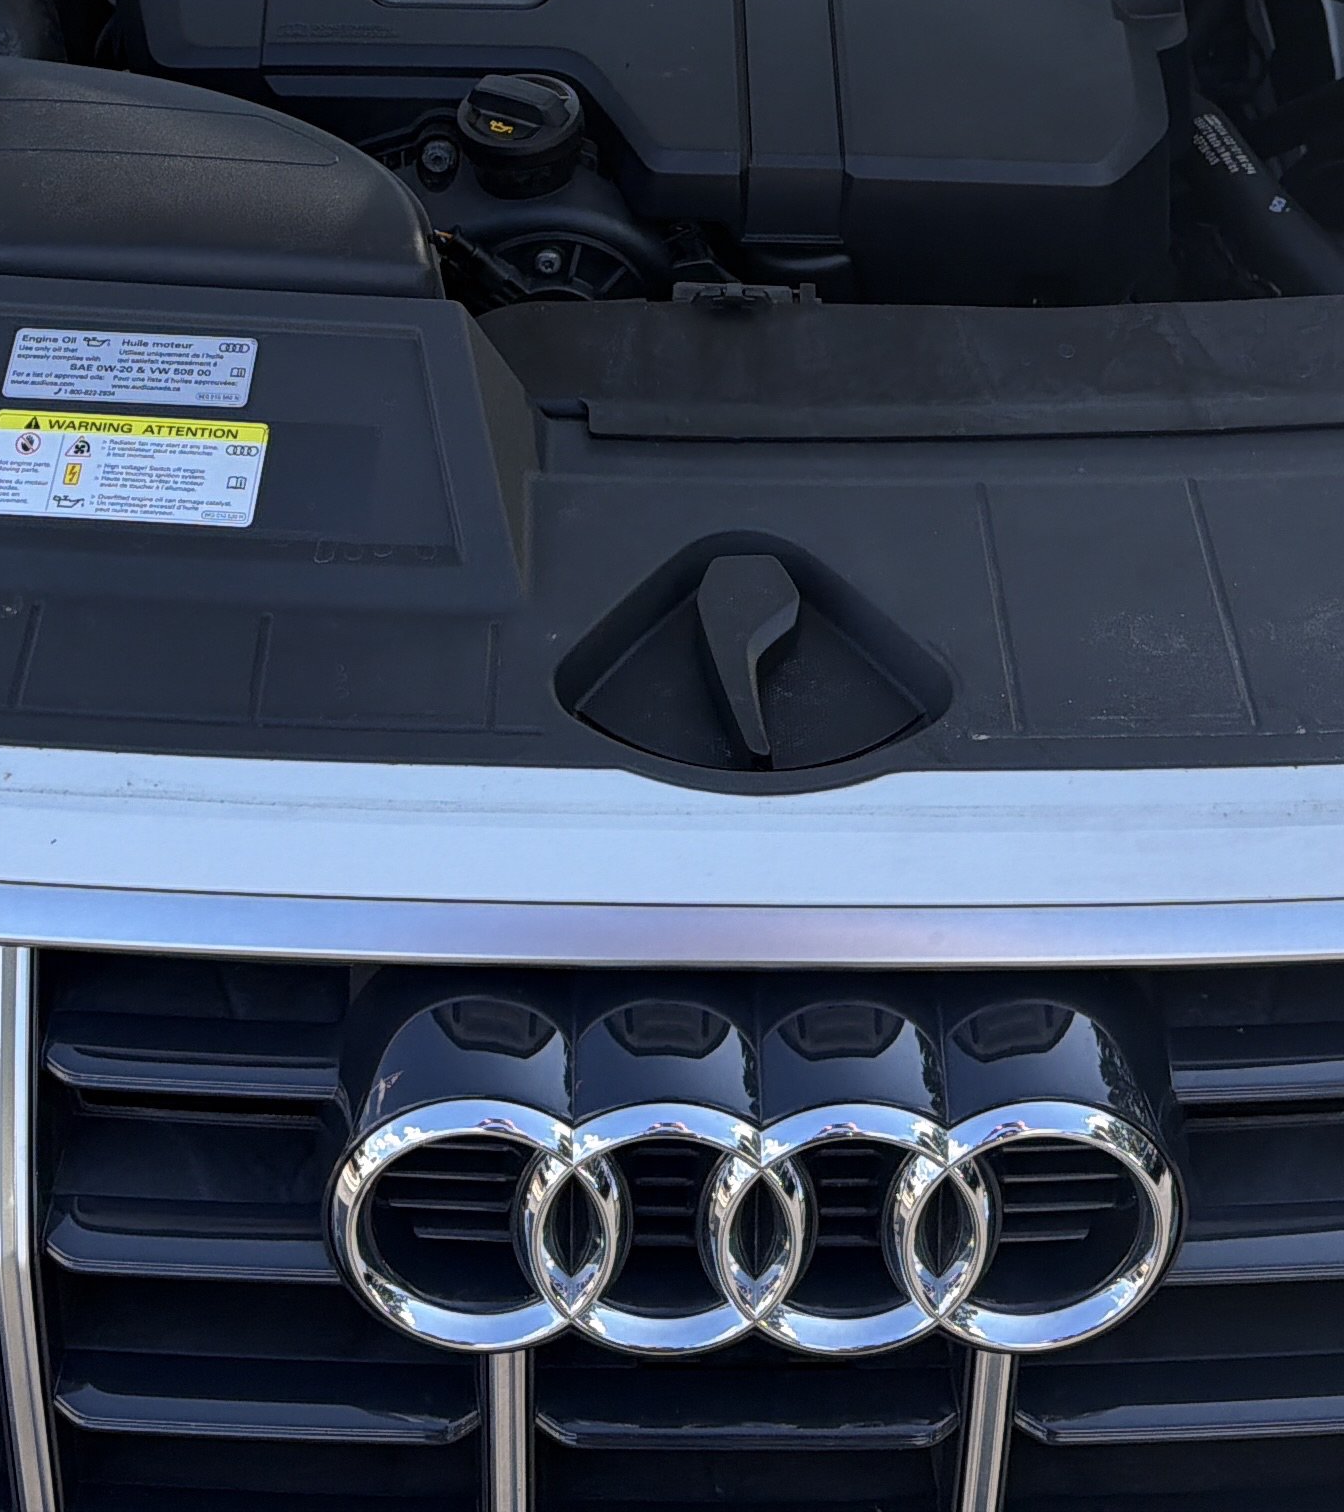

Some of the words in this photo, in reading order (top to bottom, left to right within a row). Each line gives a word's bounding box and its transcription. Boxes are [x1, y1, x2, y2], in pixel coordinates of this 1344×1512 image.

[22, 334, 59, 343] Engine
[62, 336, 77, 344] Oil
[122, 339, 149, 347] Huile
[152, 340, 194, 349] moteur
[96, 365, 133, 373] 0W-20
[150, 367, 171, 375] VW
[173, 368, 193, 376] 508
[48, 419, 133, 434] WARNING
[142, 424, 239, 439] ATTENTION
